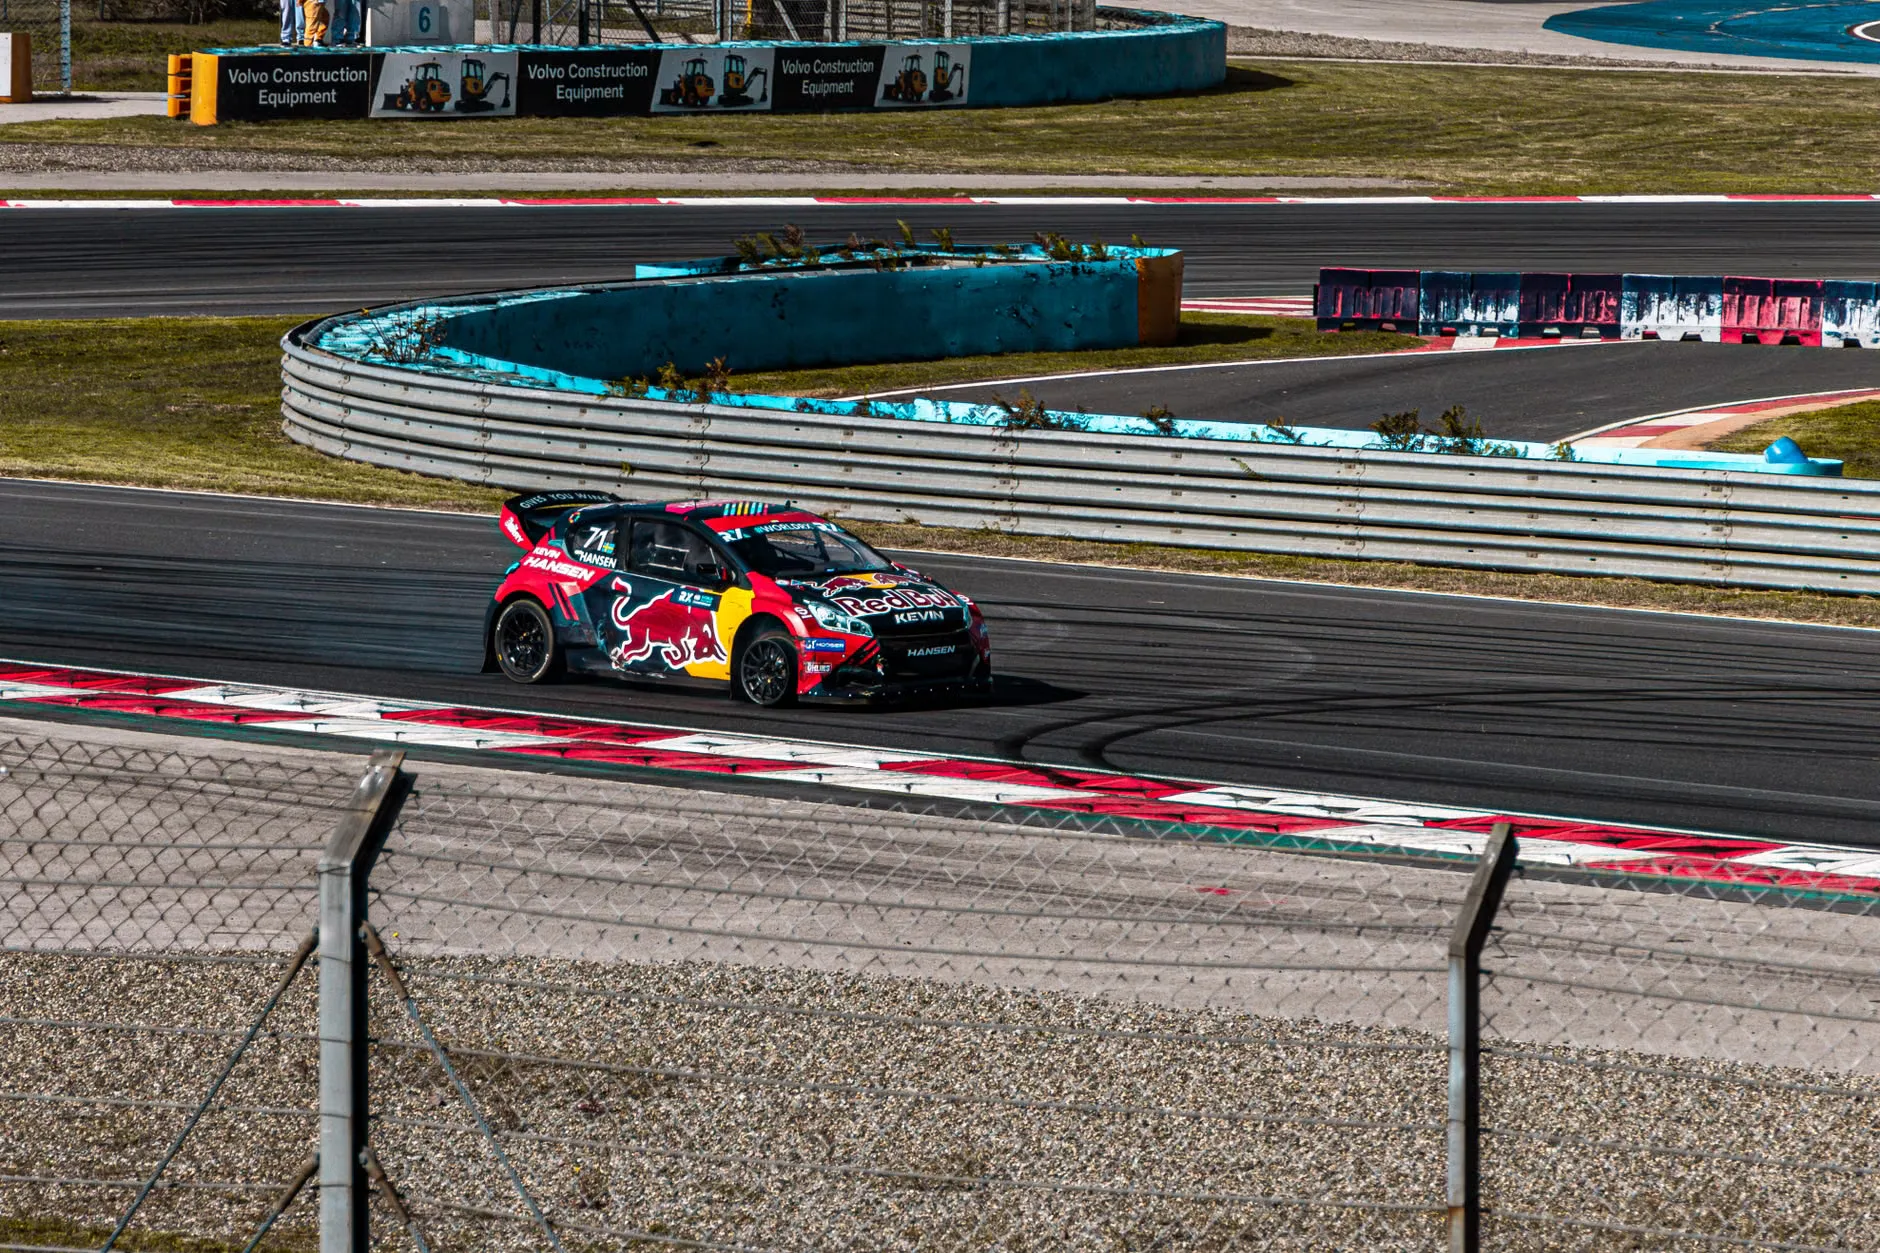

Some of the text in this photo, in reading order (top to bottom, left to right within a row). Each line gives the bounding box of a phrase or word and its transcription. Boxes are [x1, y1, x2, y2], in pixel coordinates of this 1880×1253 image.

[418, 7, 431, 33] 6
[527, 62, 648, 80] Volvo Construction
[781, 58, 874, 74] Volvo Construction
[228, 67, 368, 84] Volvo Construction
[556, 84, 624, 102] Equipment
[801, 79, 854, 96] Equipment
[258, 89, 337, 106] Equipment
[519, 495, 547, 508] GIVES
[574, 492, 612, 502] WING
[583, 526, 609, 552] 71
[532, 546, 562, 559] KEVIN
[579, 551, 617, 568] HANSEN
[523, 556, 595, 582] HANSEN
[831, 587, 963, 617] Red Bull
[894, 610, 945, 624] KEVIN
[907, 645, 956, 657] HANSEN
